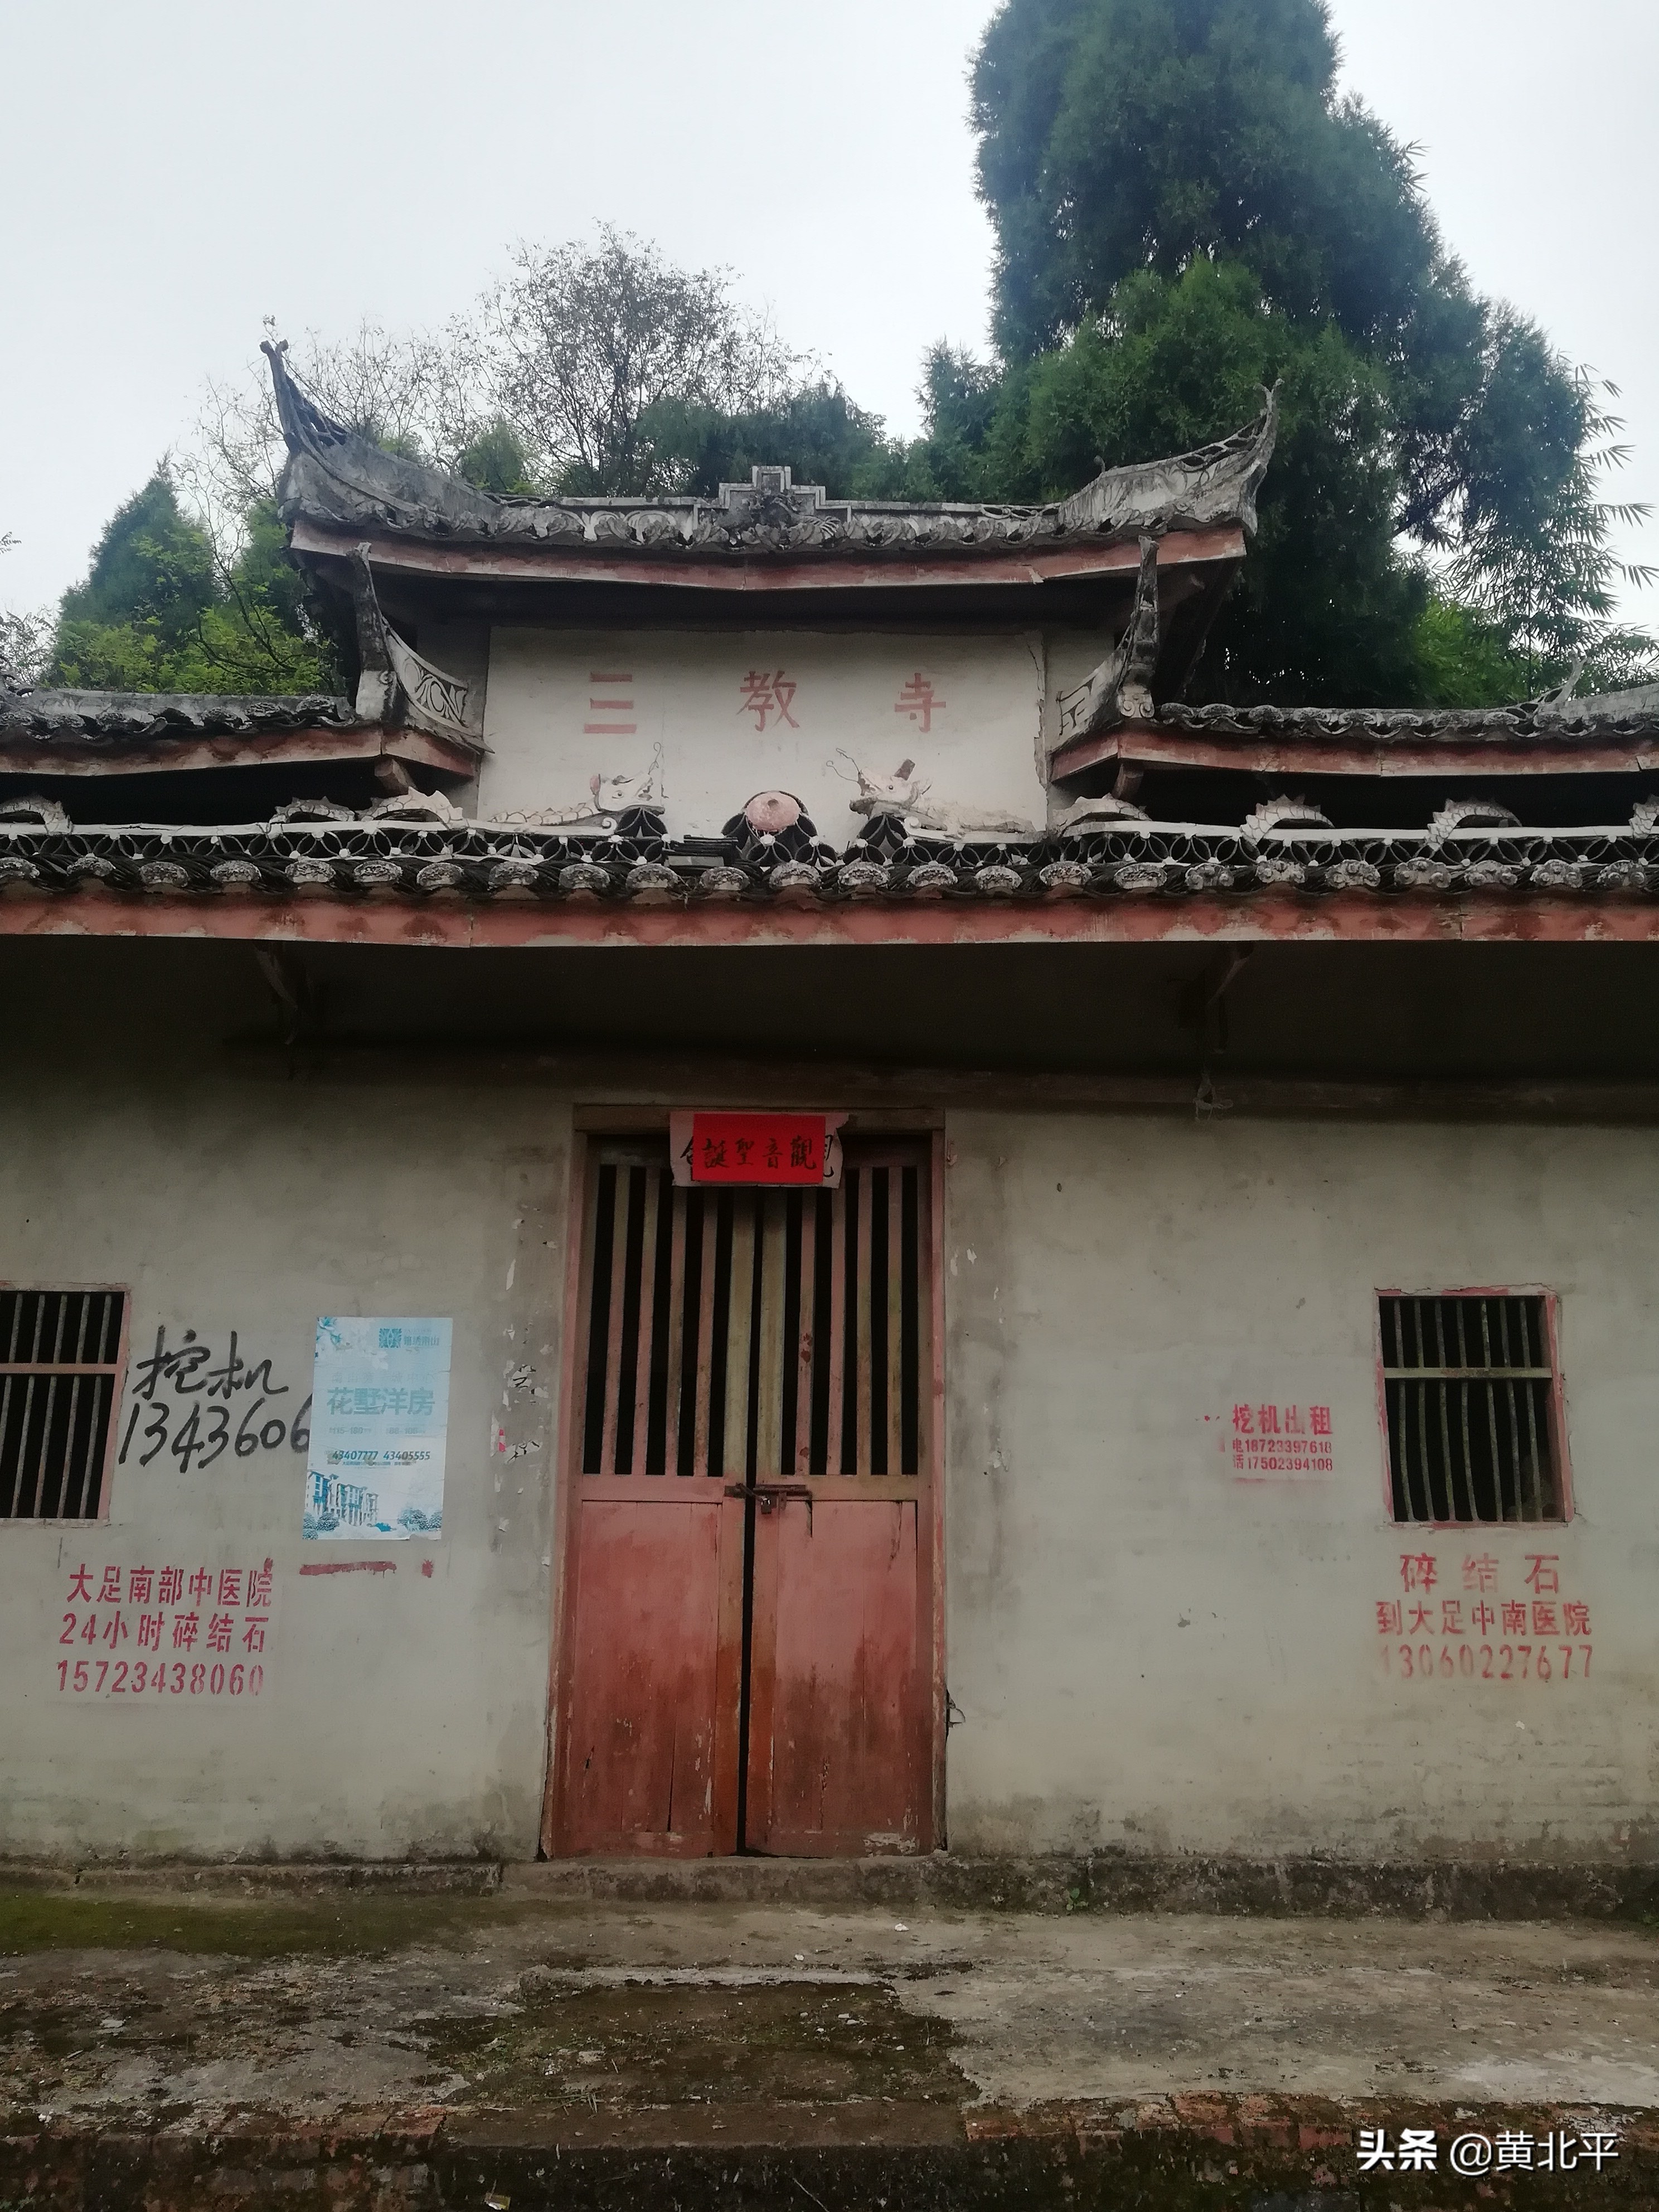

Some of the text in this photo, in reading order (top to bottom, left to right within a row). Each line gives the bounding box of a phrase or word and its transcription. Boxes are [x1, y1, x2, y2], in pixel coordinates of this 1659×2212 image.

[584, 671, 947, 733] 三教寺
[132, 1325, 289, 1400] 挖机
[327, 1387, 435, 1415] 花墅洋房
[1233, 1404, 1333, 1435] 挖机出租
[332, 1451, 430, 1461] 43407777 43405555
[1247, 1457, 1333, 1472] 17502394108
[66, 1559, 273, 1608] 大足南部中医院
[1400, 1552, 1560, 1594] 碎结石
[59, 1611, 269, 1653] 24小时碎结石
[1375, 1599, 1592, 1637] 到大足中南医院
[56, 1660, 264, 1696] 15723438060
[1379, 1644, 1593, 1680] 13060227677
